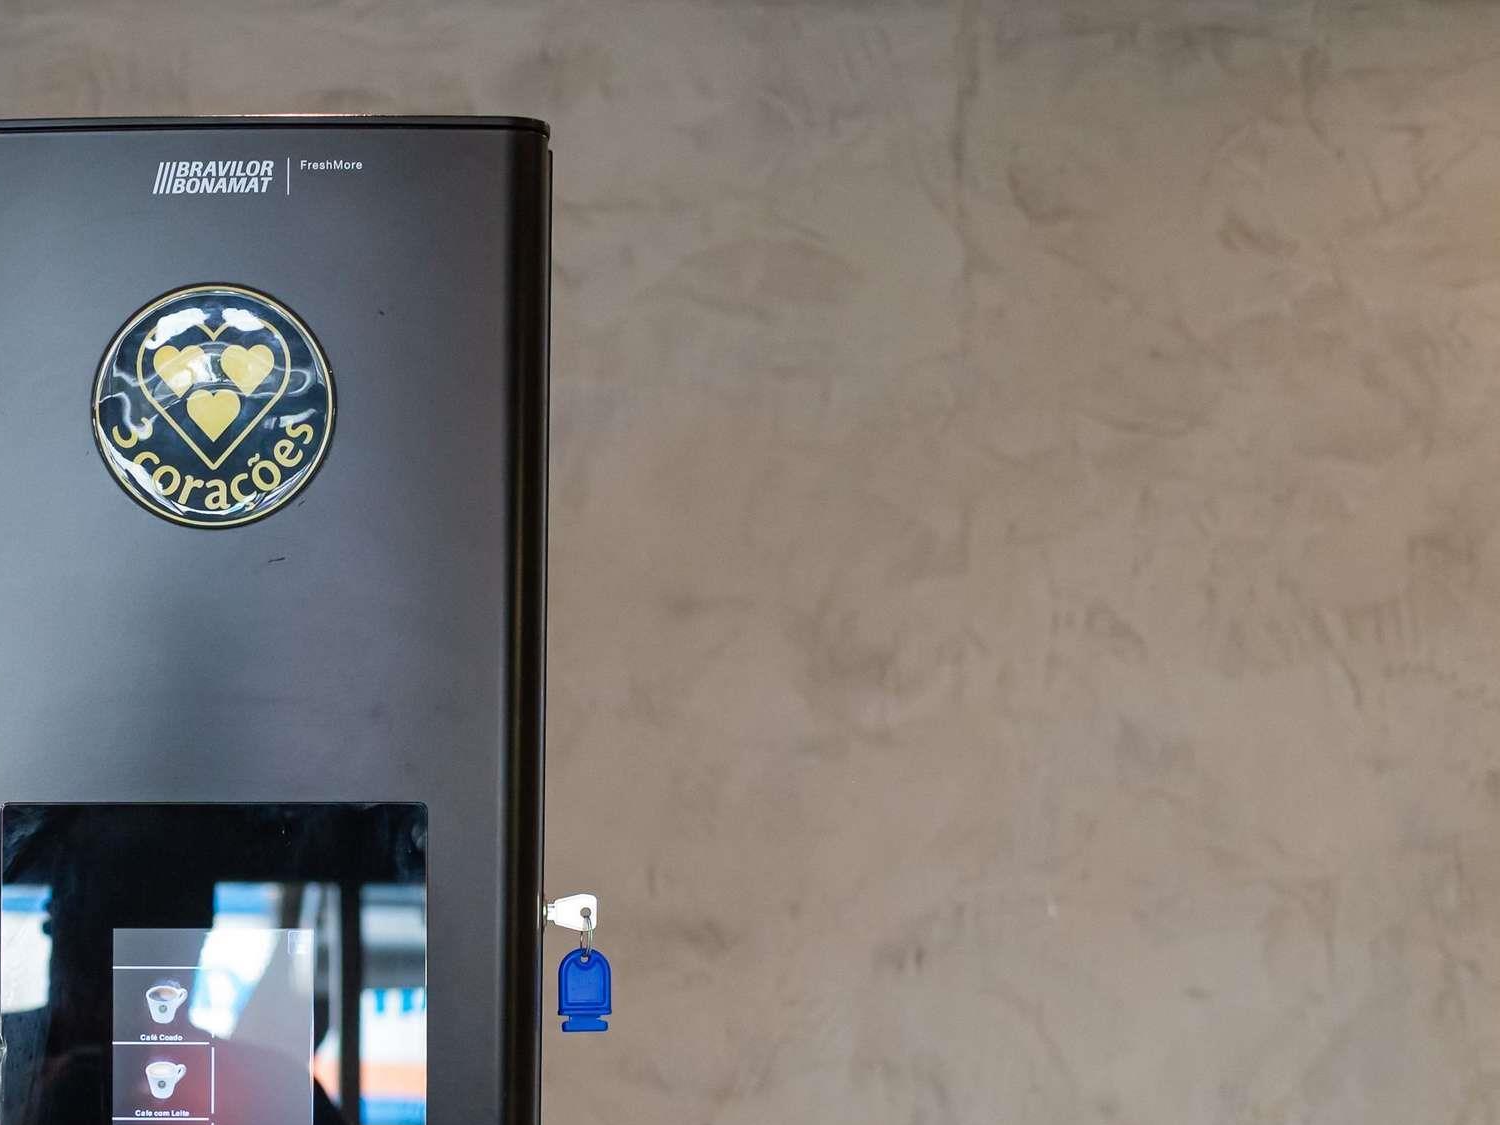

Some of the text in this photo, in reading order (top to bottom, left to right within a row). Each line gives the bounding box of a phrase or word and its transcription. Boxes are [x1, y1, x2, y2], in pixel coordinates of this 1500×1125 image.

[175, 160, 274, 177] BRAVILOR
[300, 159, 363, 171] FreshMore
[171, 176, 273, 194] BONAMAT
[171, 1109, 190, 1117] Leite
